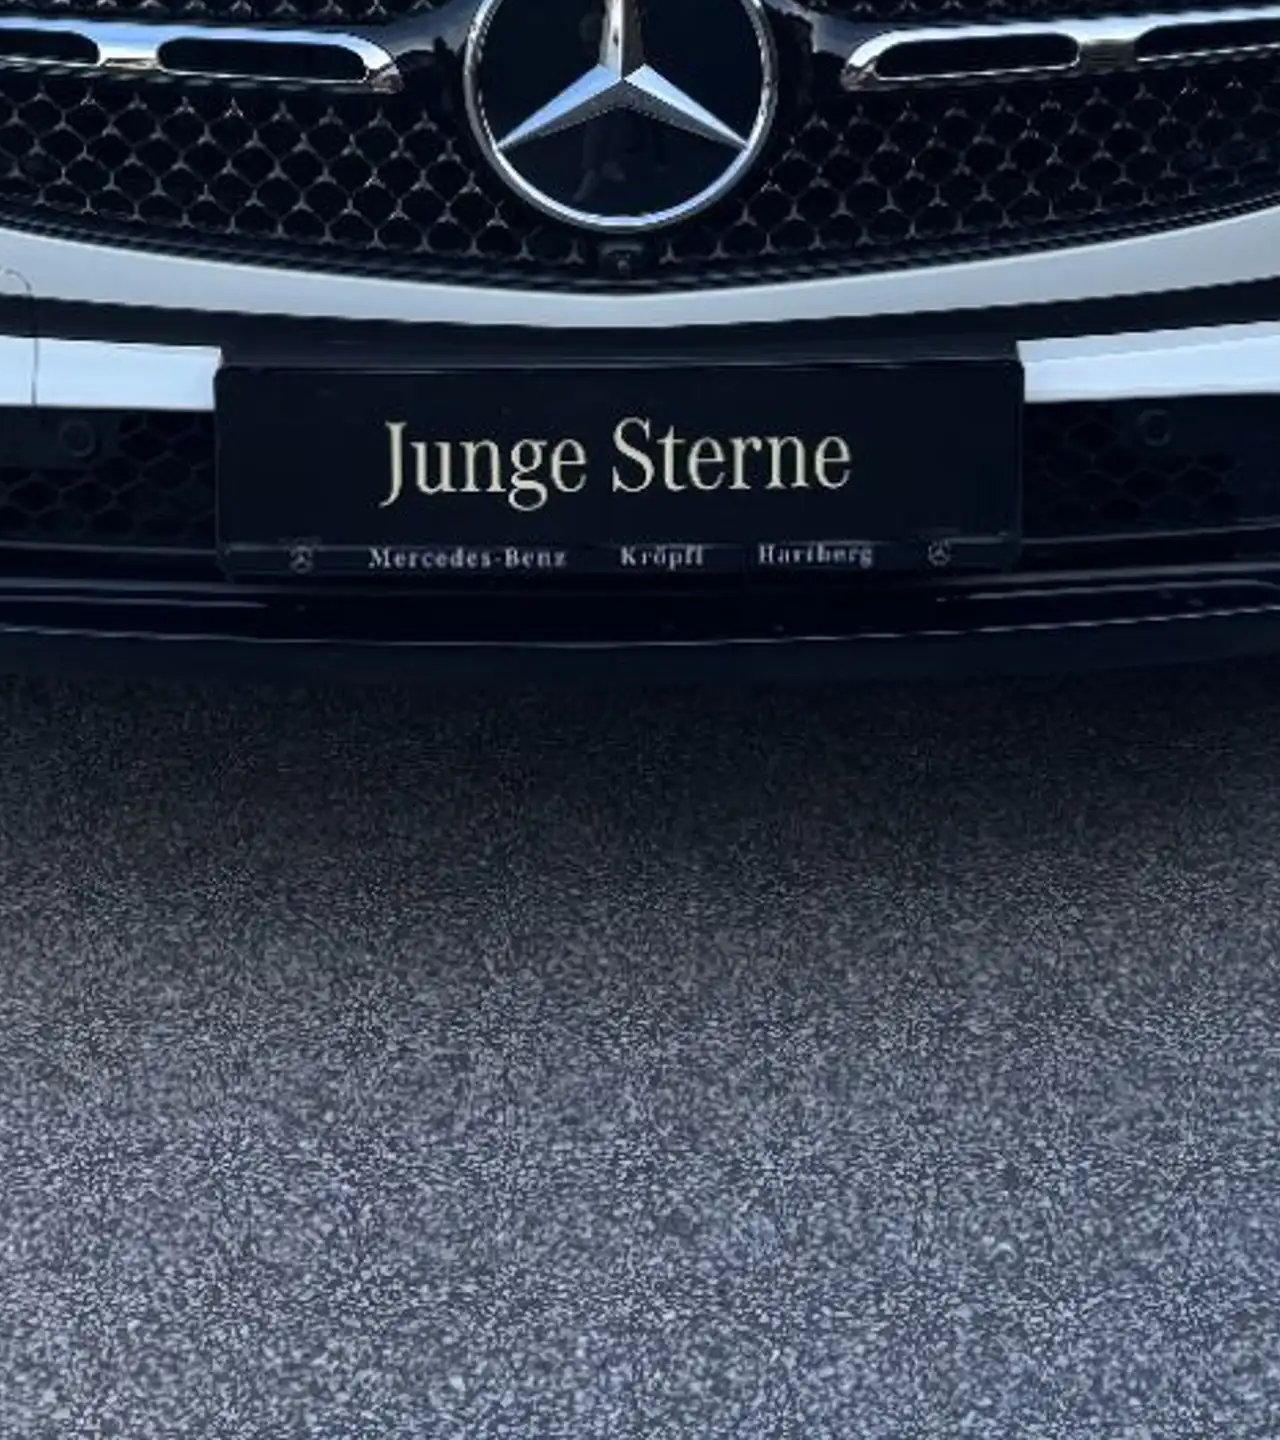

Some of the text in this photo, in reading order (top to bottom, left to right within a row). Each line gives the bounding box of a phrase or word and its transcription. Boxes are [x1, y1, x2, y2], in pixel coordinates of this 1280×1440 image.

[379, 416, 852, 512] Junge Sterne
[369, 546, 568, 570] Mercedes-Benz
[758, 543, 874, 570] Hartberg
